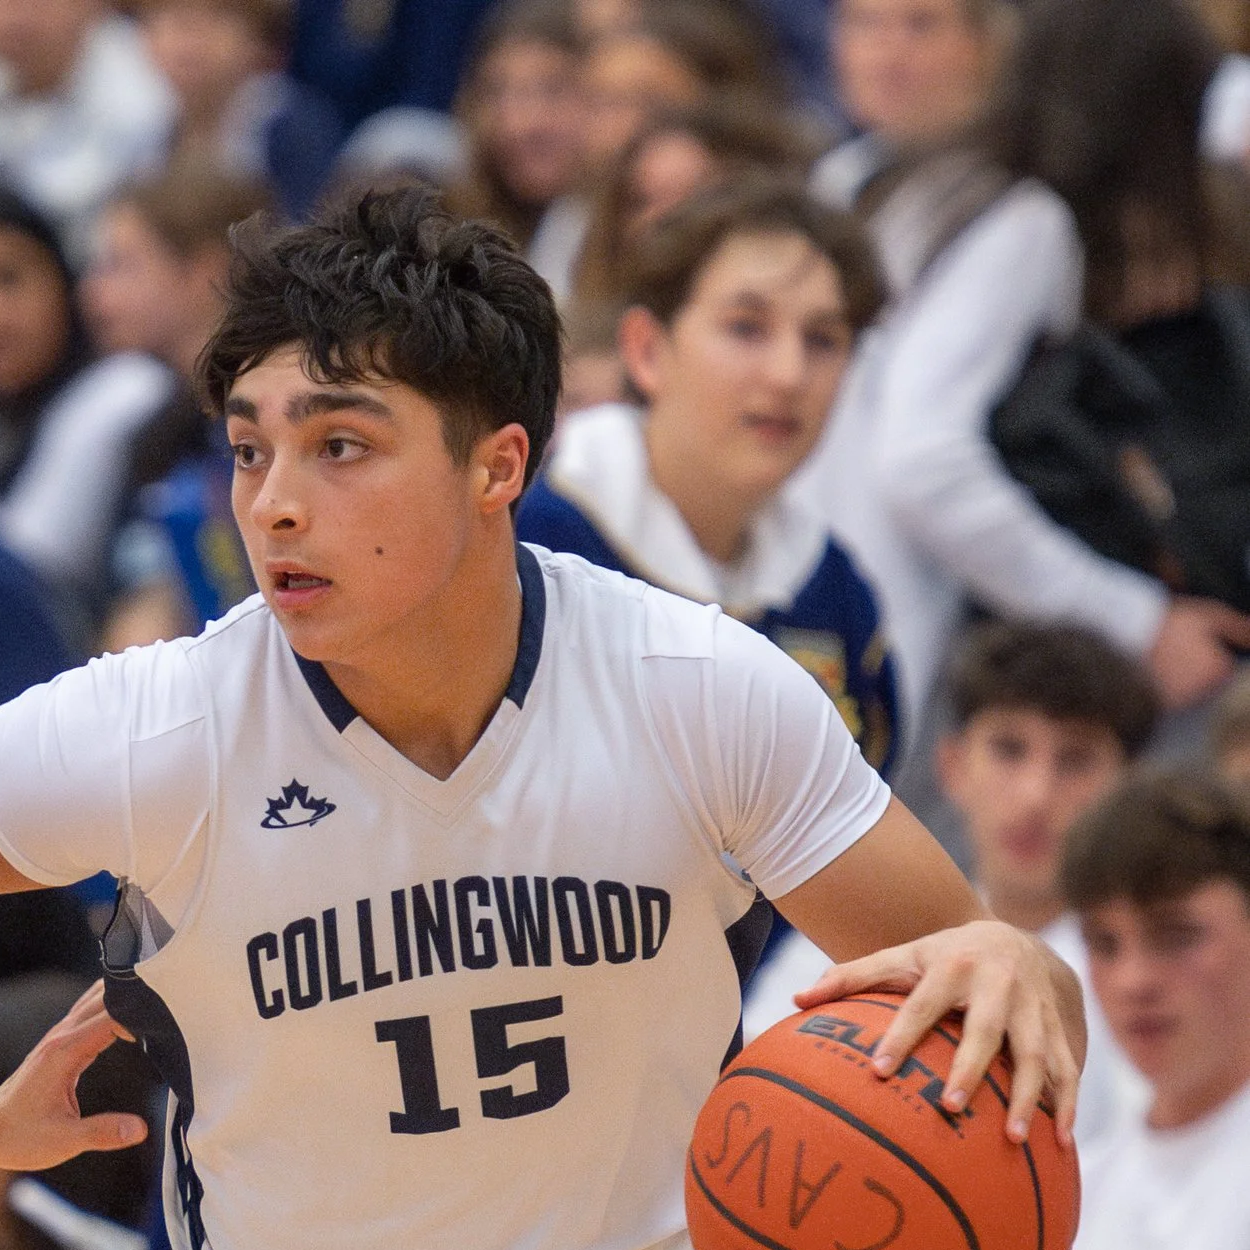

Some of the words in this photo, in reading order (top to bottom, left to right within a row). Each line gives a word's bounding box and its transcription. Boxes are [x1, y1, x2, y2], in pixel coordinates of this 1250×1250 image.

[246, 875, 671, 1019] COLLINGWOOD
[375, 995, 570, 1135] 15
[796, 1014, 973, 1132] ELTE
